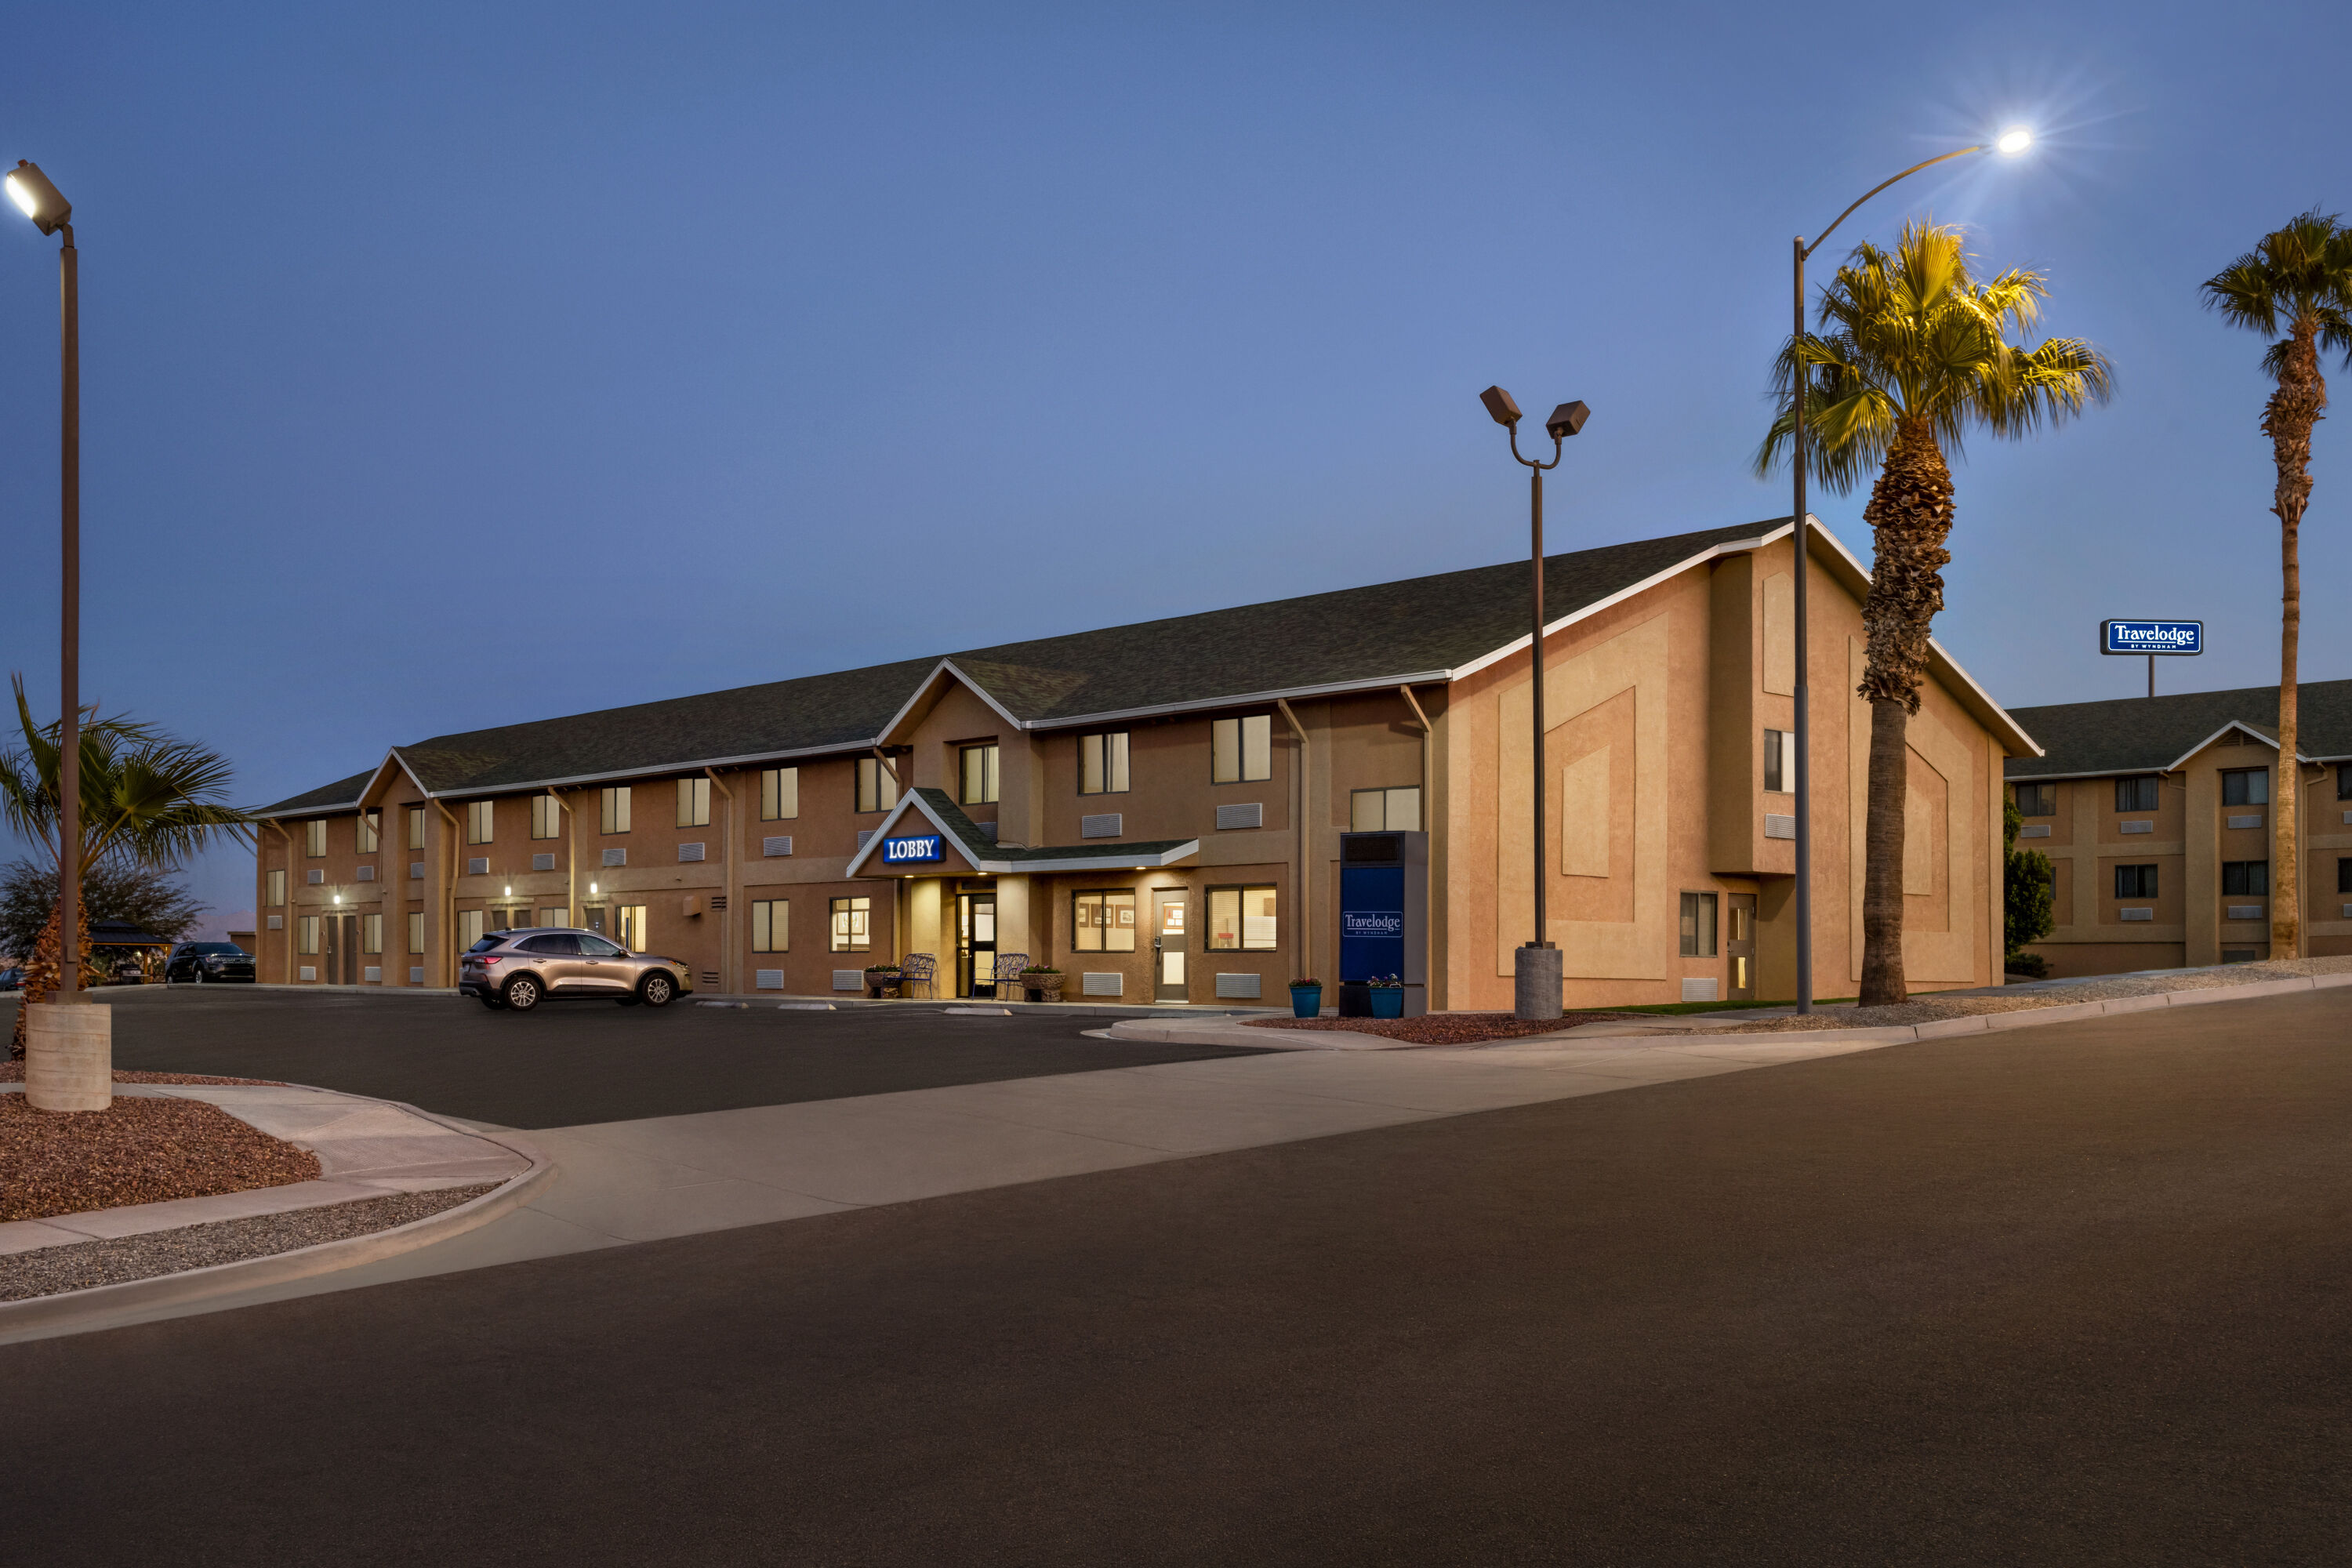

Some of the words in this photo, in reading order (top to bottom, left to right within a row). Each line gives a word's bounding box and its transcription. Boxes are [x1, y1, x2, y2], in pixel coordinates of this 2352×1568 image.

[2114, 625, 2194, 645] Travelodge
[889, 839, 935, 859] LOBBY
[1345, 913, 1400, 931] Travelodge
